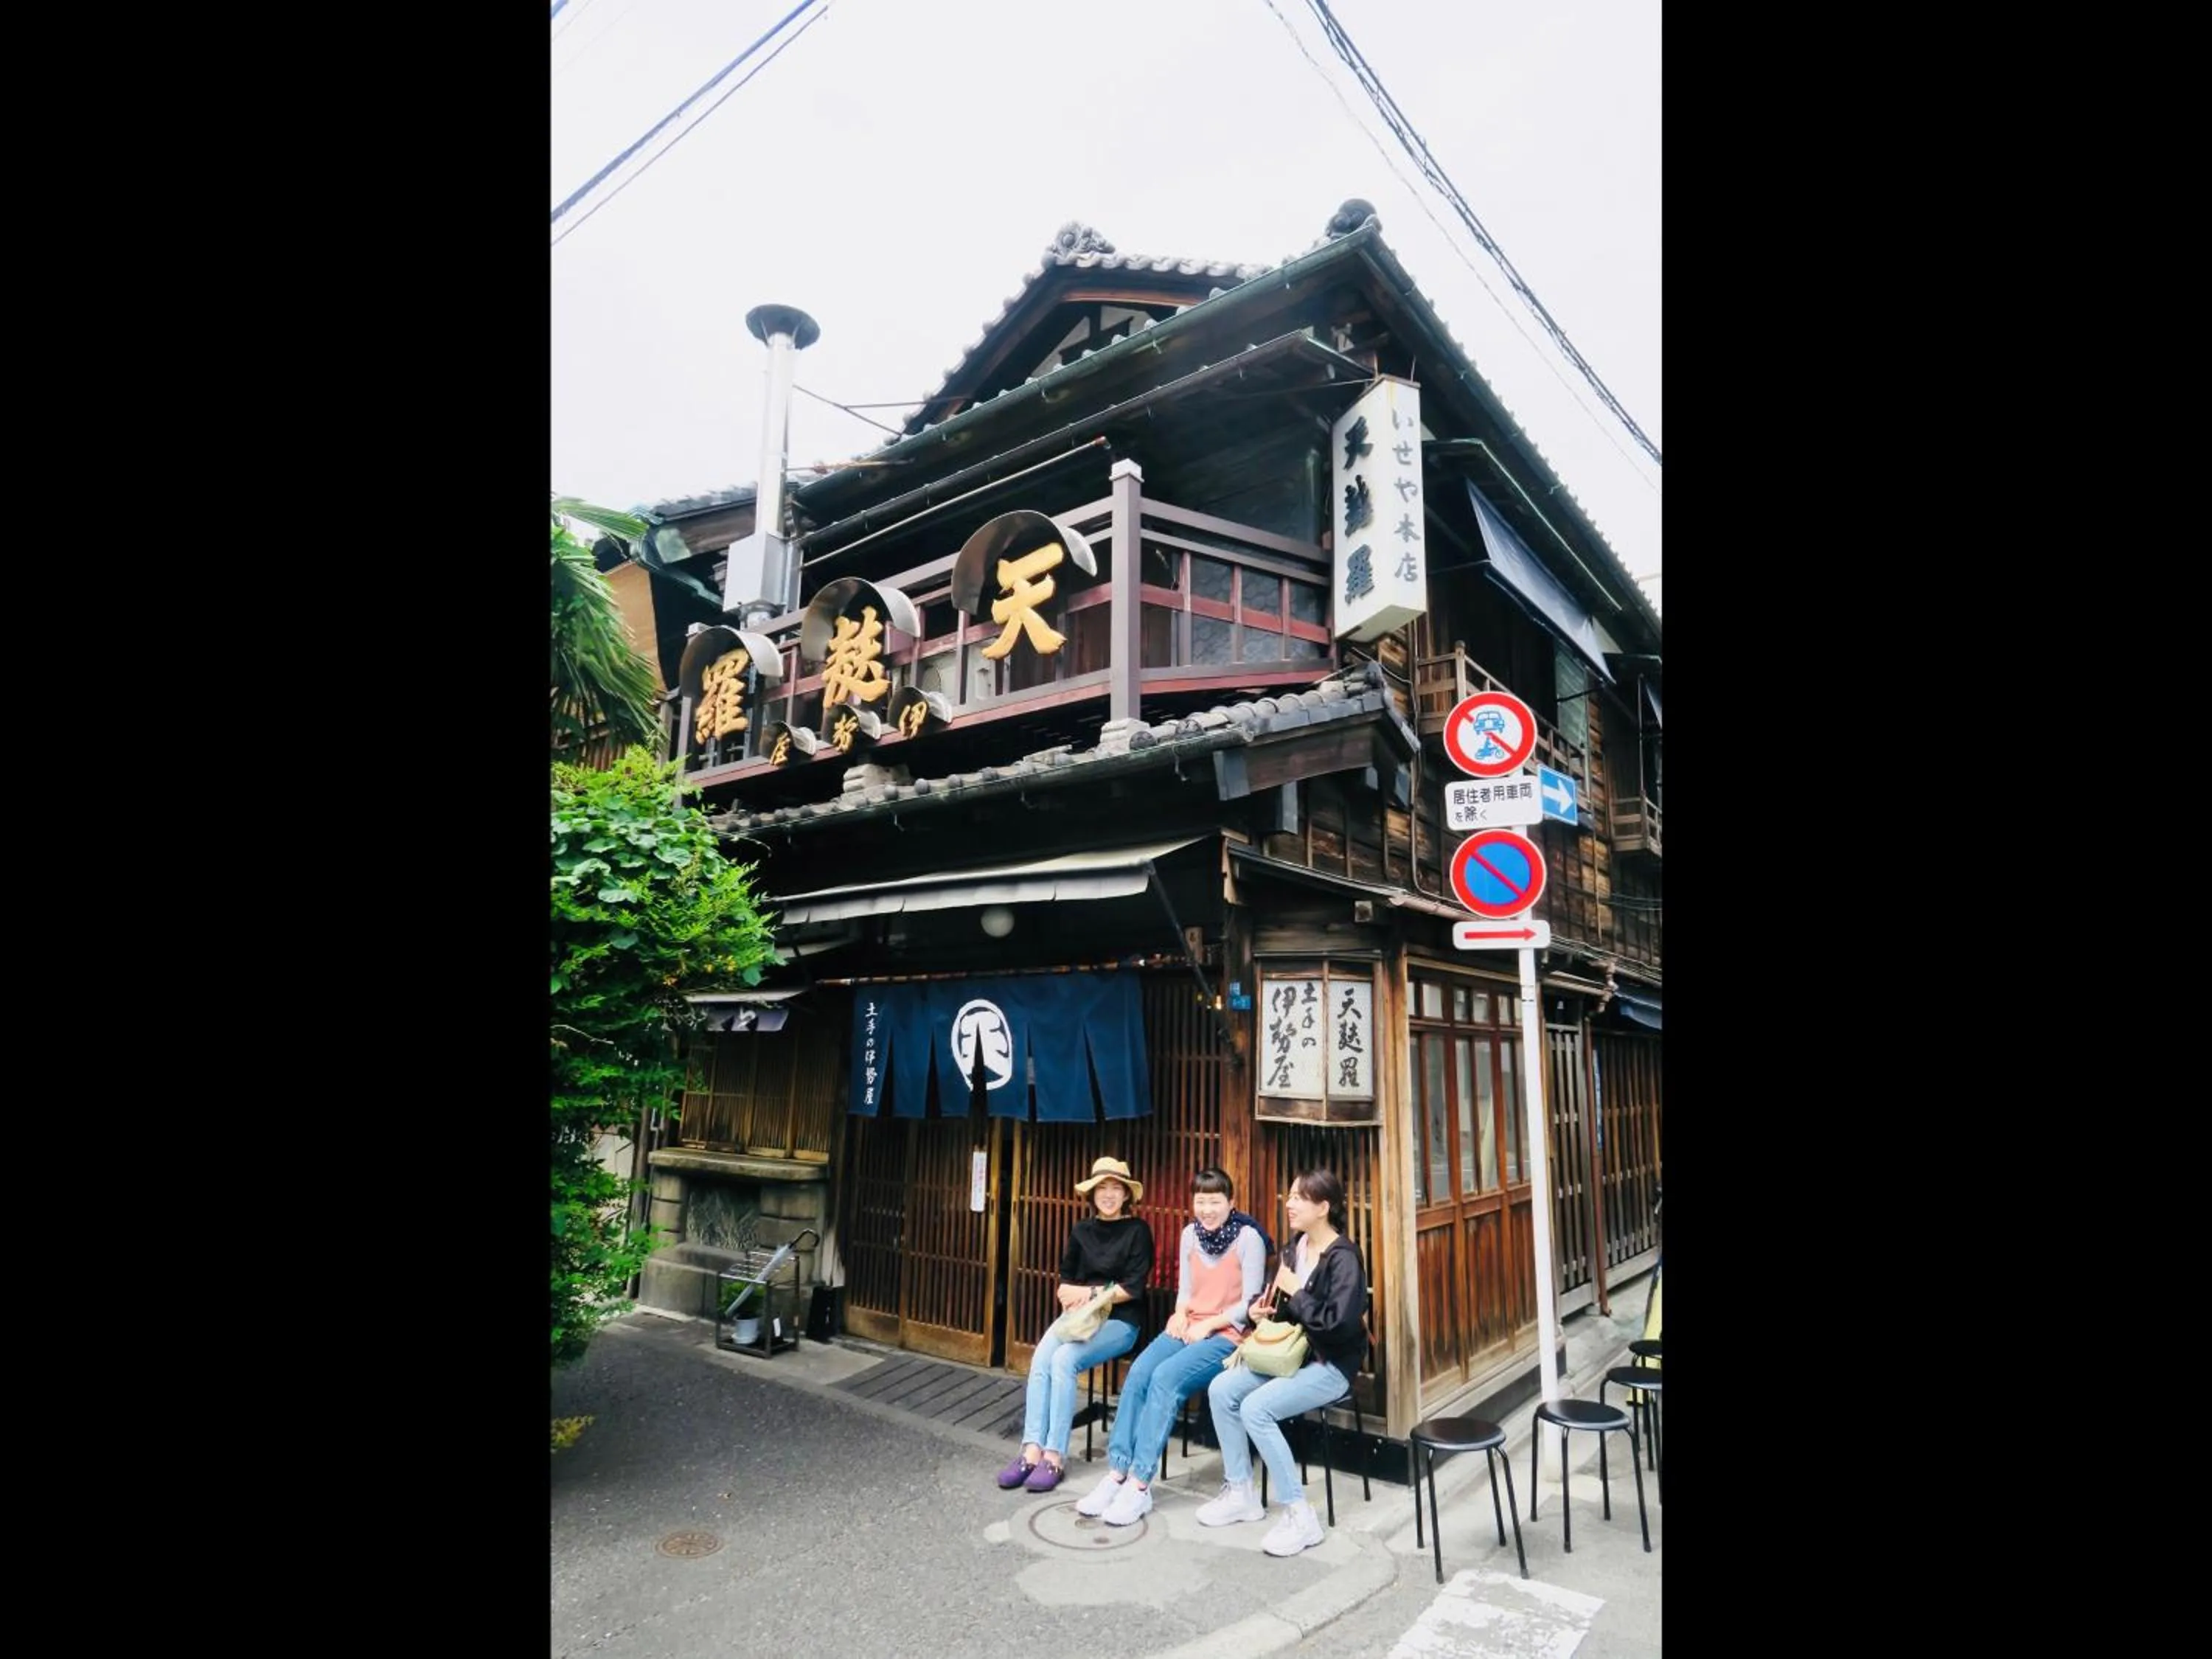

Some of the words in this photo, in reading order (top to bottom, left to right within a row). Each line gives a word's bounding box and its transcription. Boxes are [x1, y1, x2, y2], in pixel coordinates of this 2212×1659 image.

[1392, 408, 1421, 582] いせや本店
[1453, 782, 1532, 804] 居住者用車両
[1455, 806, 1487, 822] を除く
[1301, 981, 1318, 1048] 土手の
